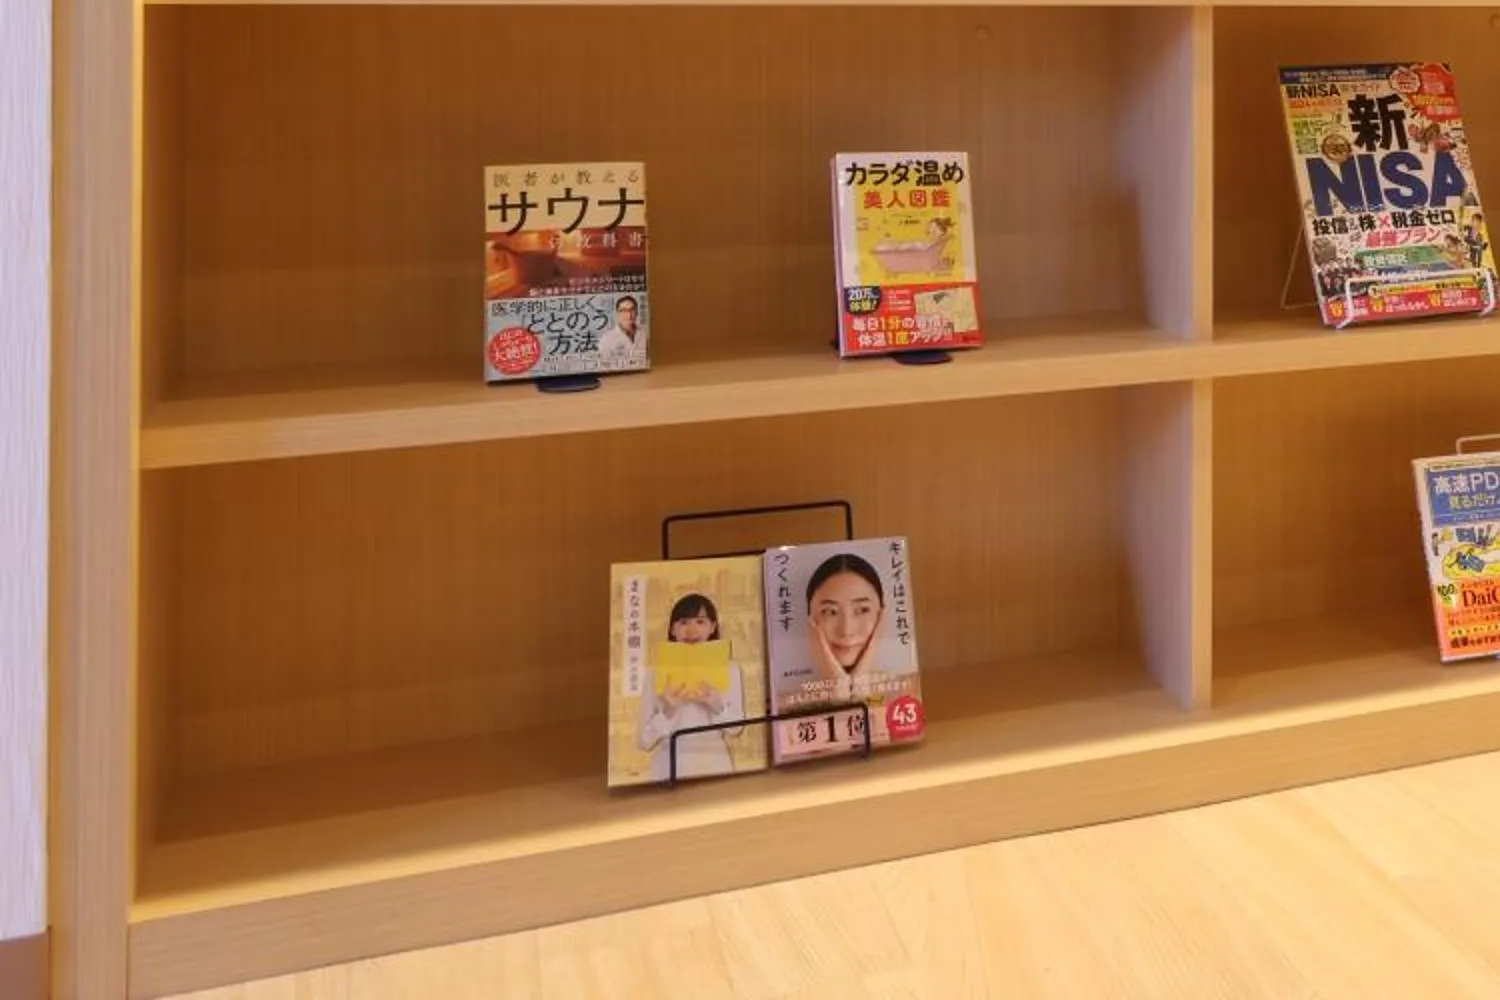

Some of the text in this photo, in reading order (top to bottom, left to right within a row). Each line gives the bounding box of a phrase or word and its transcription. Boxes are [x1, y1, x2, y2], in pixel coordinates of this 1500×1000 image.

[1347, 92, 1409, 153] 新
[845, 158, 965, 187] カラダ温め
[1304, 150, 1468, 218] NISA
[487, 187, 645, 236] サウナ
[863, 189, 953, 210] 美人図鑑
[491, 295, 596, 317] 医学的に正しく
[548, 334, 599, 355] 方法
[775, 553, 795, 634] つくれます
[887, 541, 911, 646] キレイはこれで
[796, 714, 866, 744] 第1位
[892, 703, 917, 725] 43
